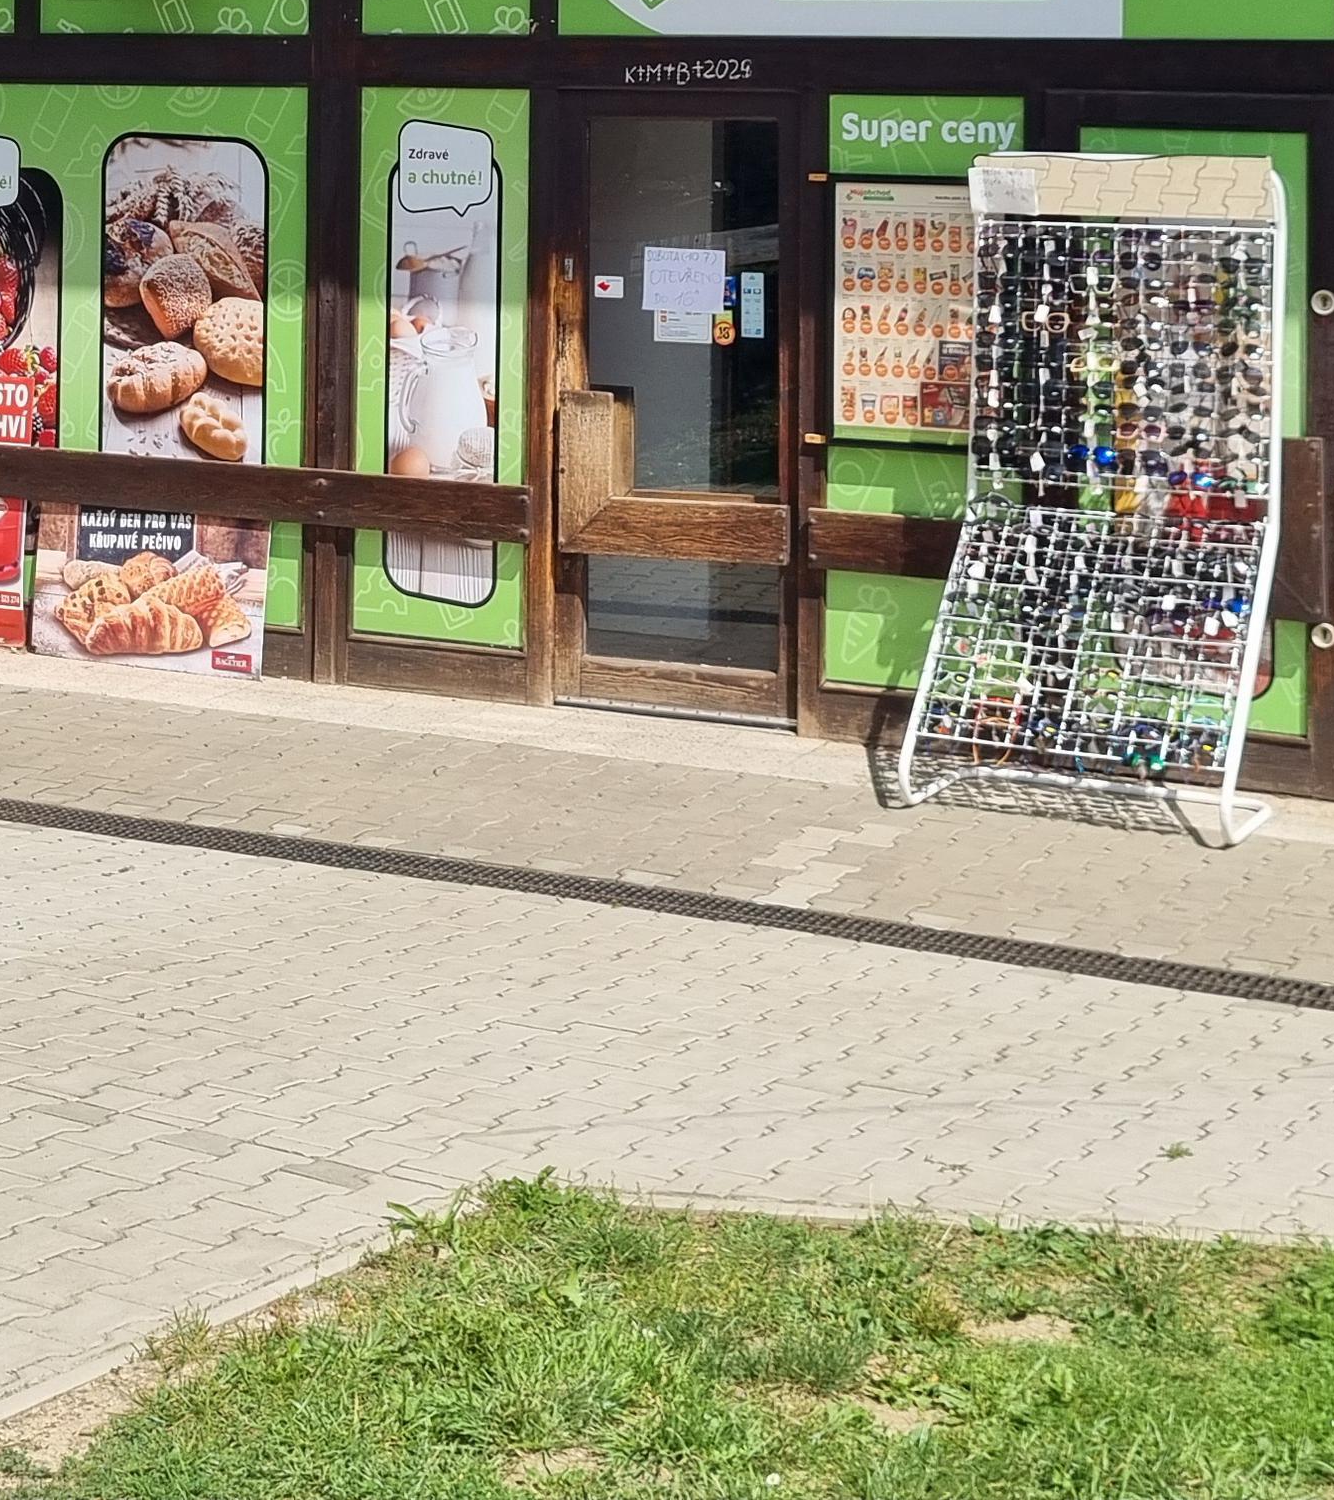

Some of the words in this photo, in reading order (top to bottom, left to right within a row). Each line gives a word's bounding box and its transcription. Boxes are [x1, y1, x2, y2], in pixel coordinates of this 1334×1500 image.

[841, 112, 933, 148] Super
[941, 120, 1017, 151] ceny
[408, 148, 450, 161] Zdravé
[408, 171, 417, 184] a
[422, 169, 483, 186] chutné!
[81, 509, 117, 528] KAŽDÝ
[119, 513, 141, 528] DEN
[144, 513, 167, 529] PRO
[89, 530, 139, 550] KŘUPAVÉ
[141, 532, 182, 551] PEČIVO
